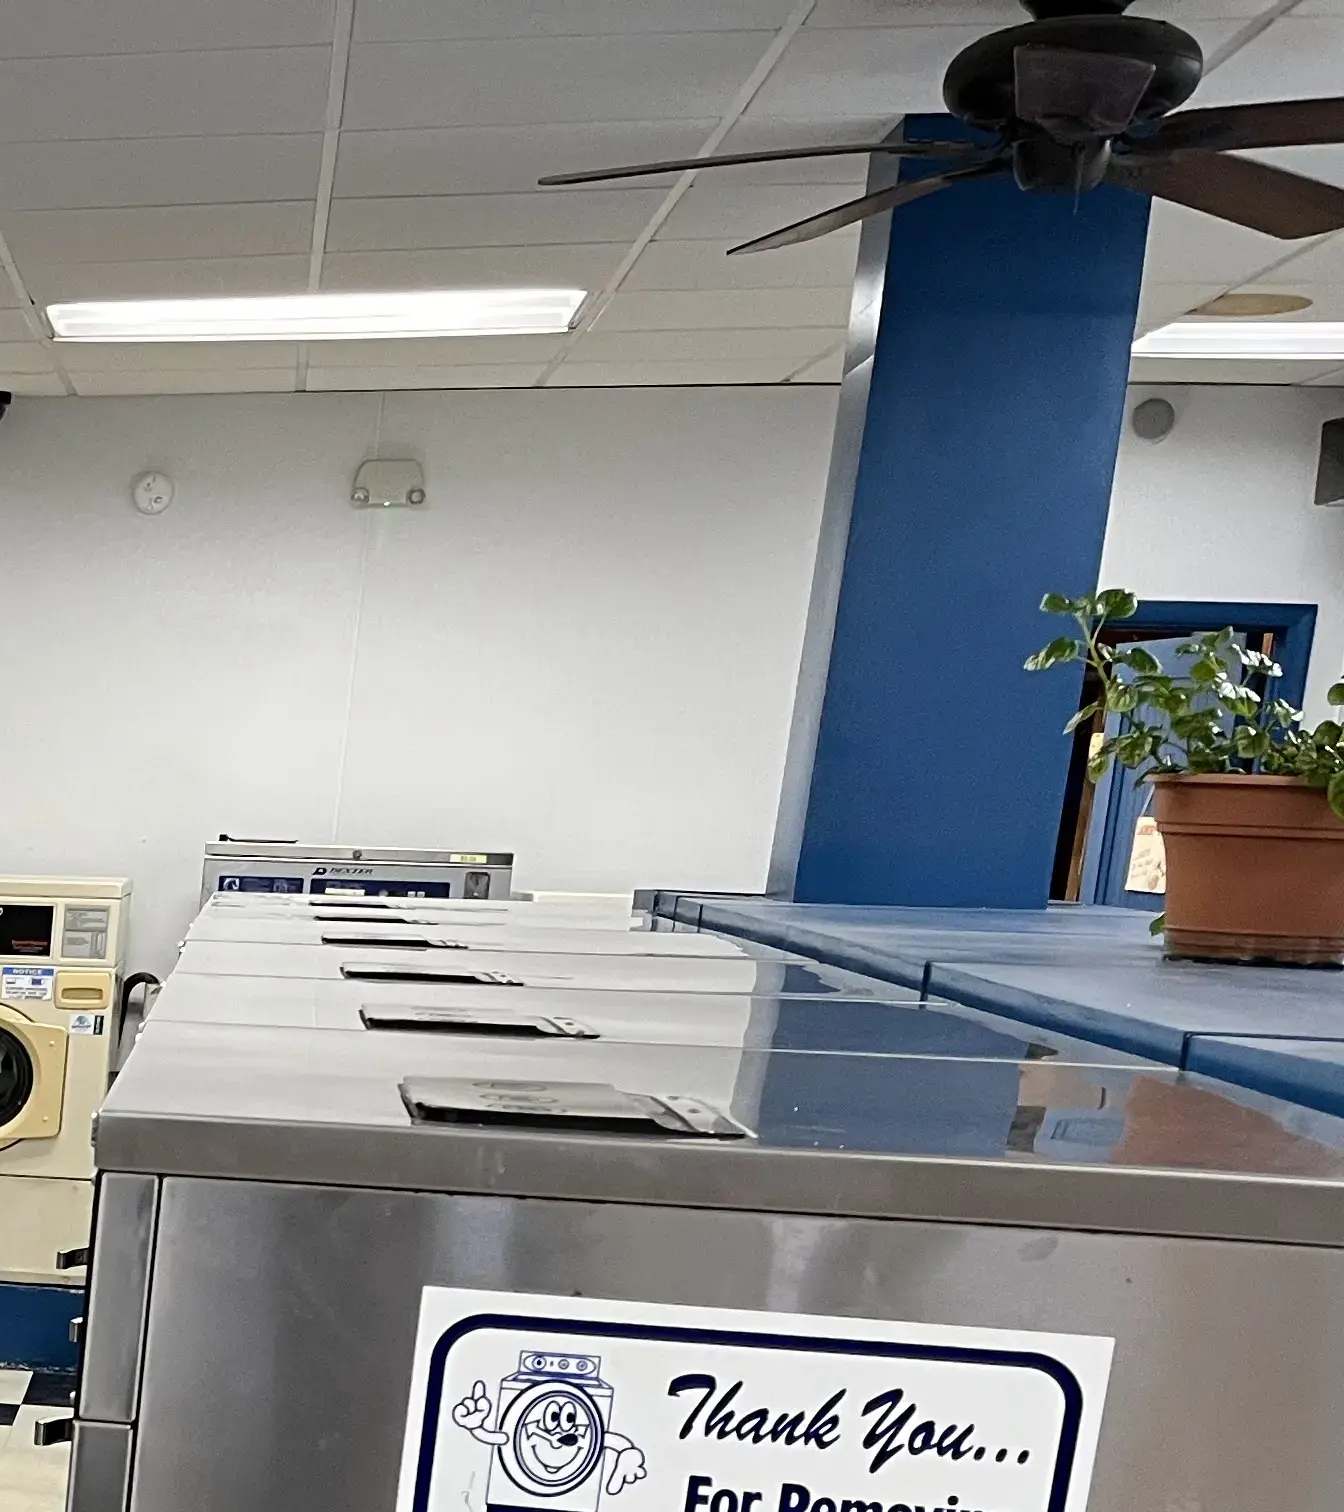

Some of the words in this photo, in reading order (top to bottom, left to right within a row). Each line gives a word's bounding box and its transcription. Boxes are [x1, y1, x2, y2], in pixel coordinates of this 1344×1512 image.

[329, 866, 374, 875] DEXTER
[666, 1373, 849, 1453] Thank
[860, 1387, 1031, 1474] You...
